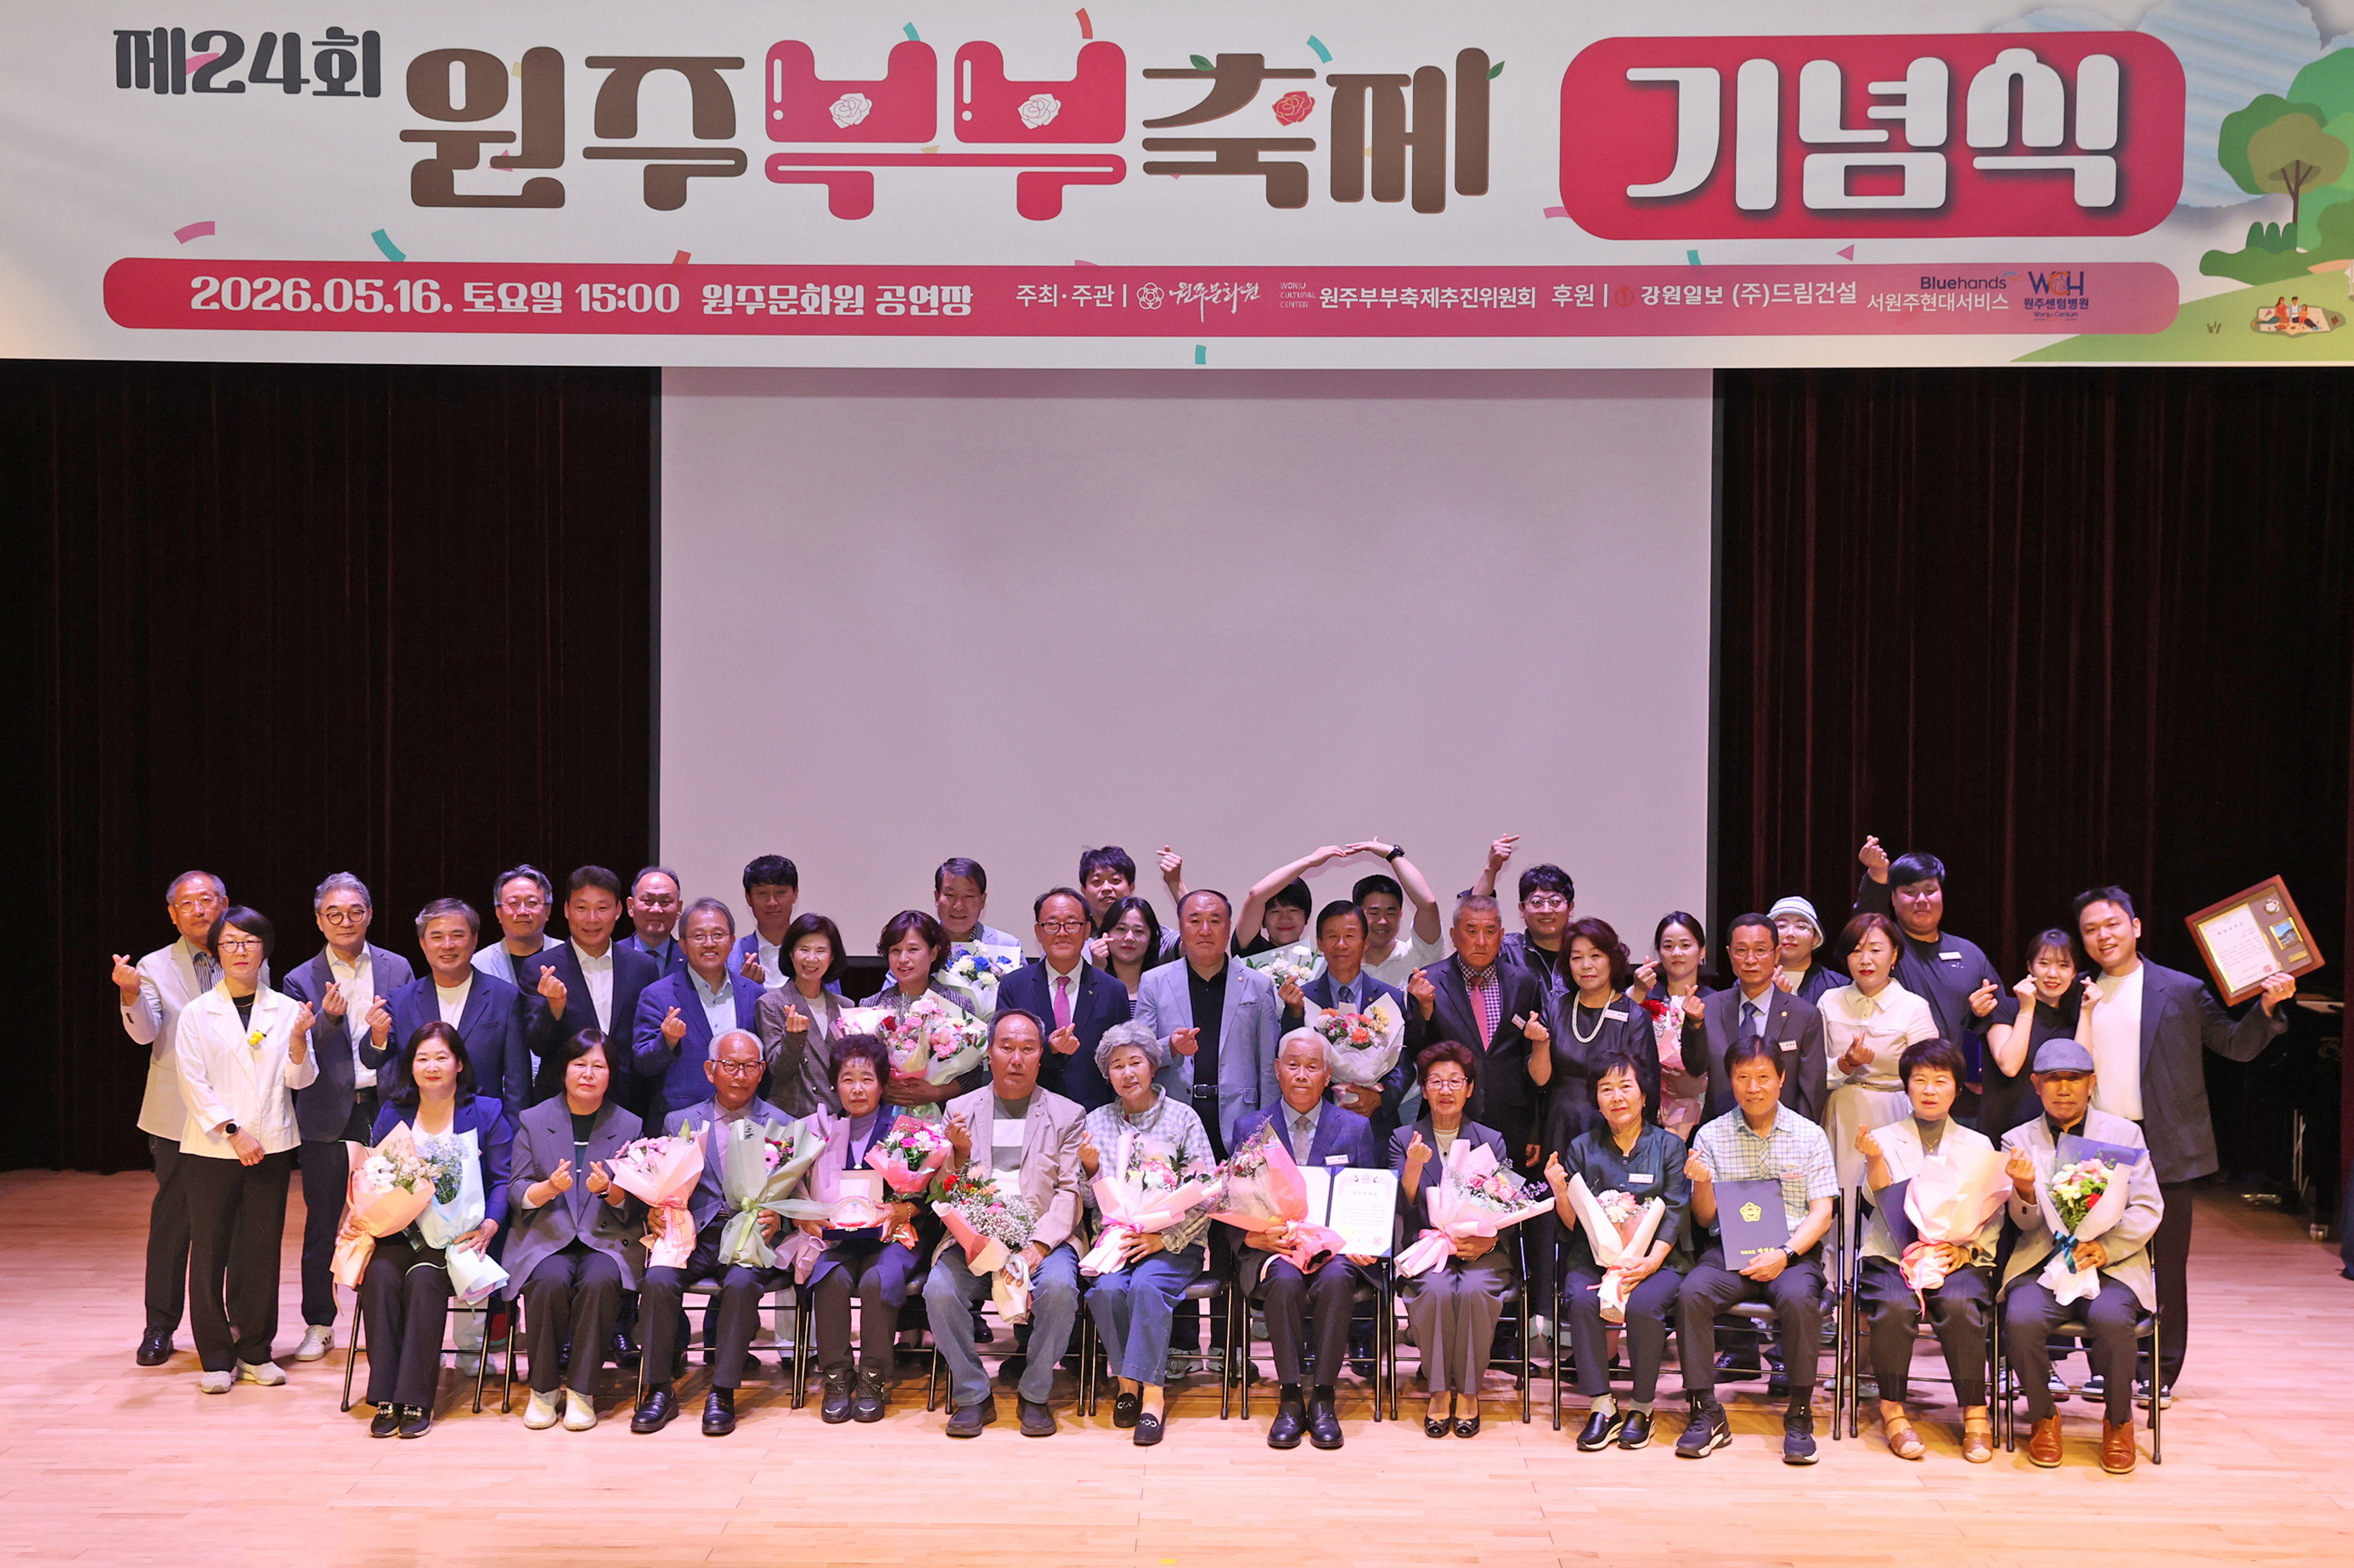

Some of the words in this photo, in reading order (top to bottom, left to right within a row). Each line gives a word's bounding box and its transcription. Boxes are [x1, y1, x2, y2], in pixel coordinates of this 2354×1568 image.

[113, 26, 380, 98] 제24회
[398, 39, 1490, 221] 원주부부축제
[1625, 48, 2120, 211] 기념식
[1920, 276, 2008, 289] Bluehands
[191, 276, 453, 313] 2026.05.16.
[463, 282, 563, 314] 토요일
[574, 283, 680, 313] 15:00
[701, 283, 864, 315] 원주문화원
[876, 285, 974, 316] 공연장
[1319, 286, 1536, 309] 원주부부축제추진위원회
[1552, 284, 1594, 307] 후원
[1641, 285, 1724, 306] 강원일보
[1731, 281, 1857, 308] (주)드림건설
[1867, 292, 2009, 312] 서원주현대서비스
[2024, 297, 2089, 310] 원주센텀병원
